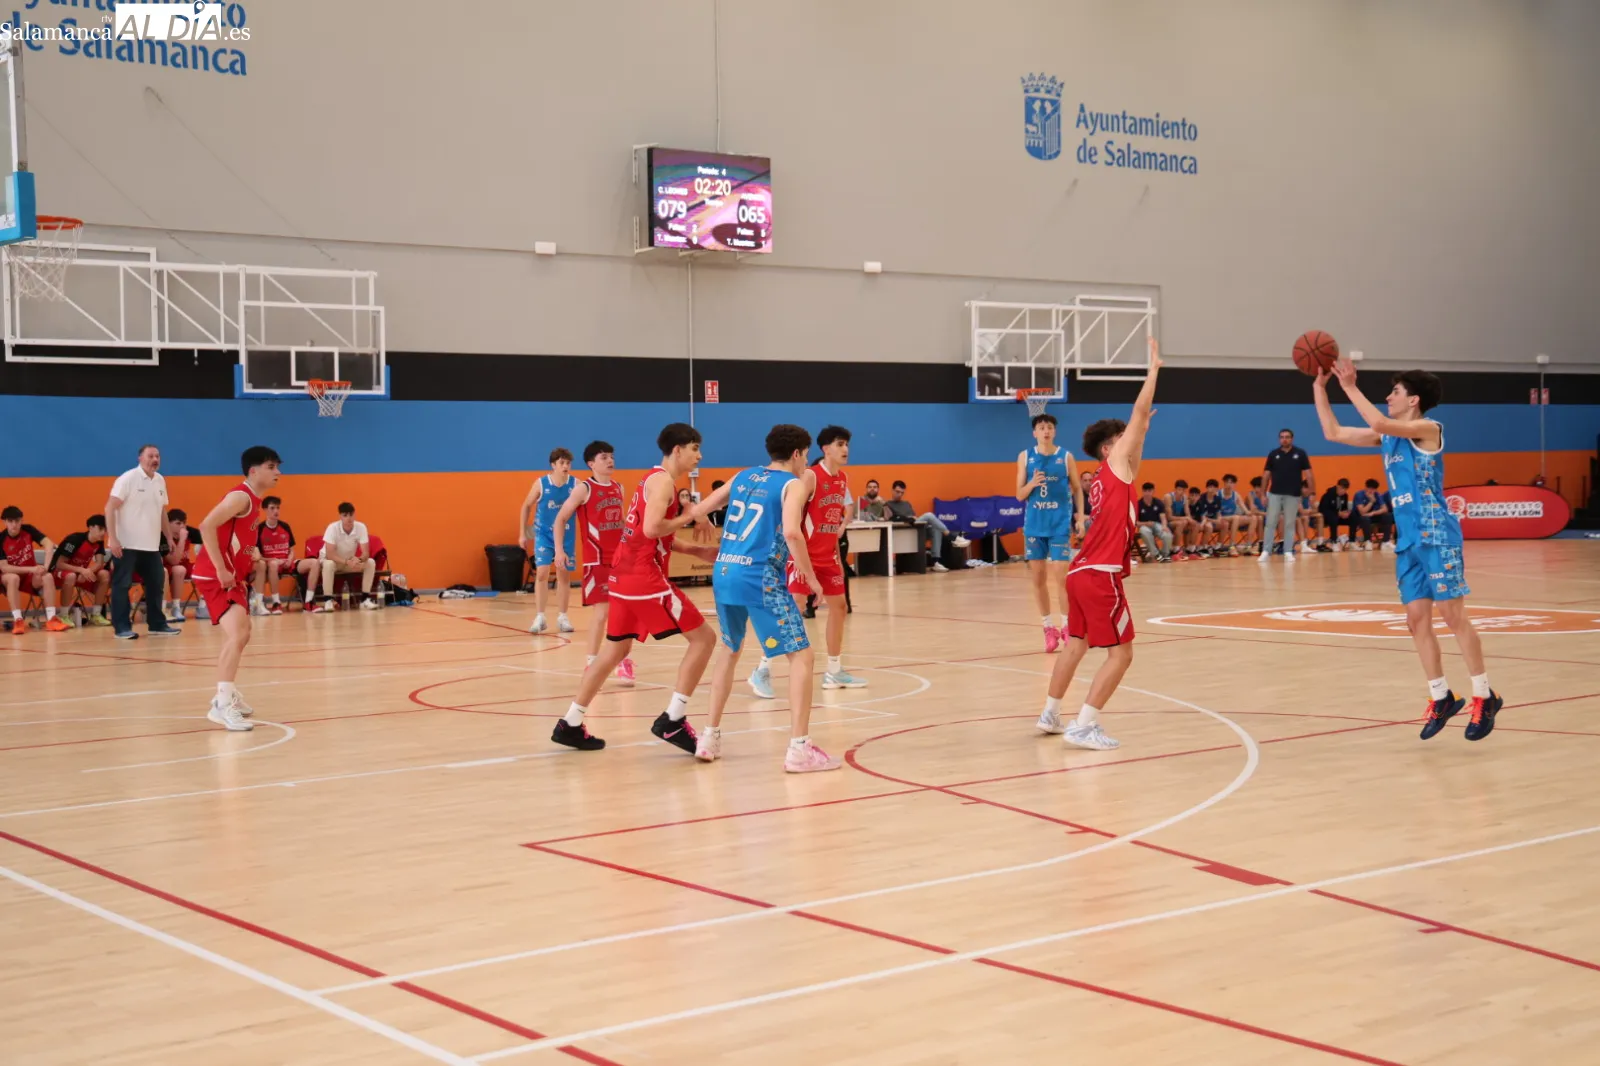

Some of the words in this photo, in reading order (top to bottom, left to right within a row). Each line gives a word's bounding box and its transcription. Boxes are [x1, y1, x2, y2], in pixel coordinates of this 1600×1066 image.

[1076, 102, 1198, 142] Ayuntamiento
[1076, 137, 1098, 165] de
[1104, 140, 1198, 175] Salamanca
[694, 178, 731, 195] 02:20
[658, 199, 688, 218] 079
[738, 205, 766, 224] 065
[1040, 485, 1048, 498] 8
[1467, 502, 1541, 510] BALONCESTO
[1469, 510, 1508, 518] CASTILLA
[1518, 508, 1541, 517] LEÓN
[722, 499, 764, 542] 27
